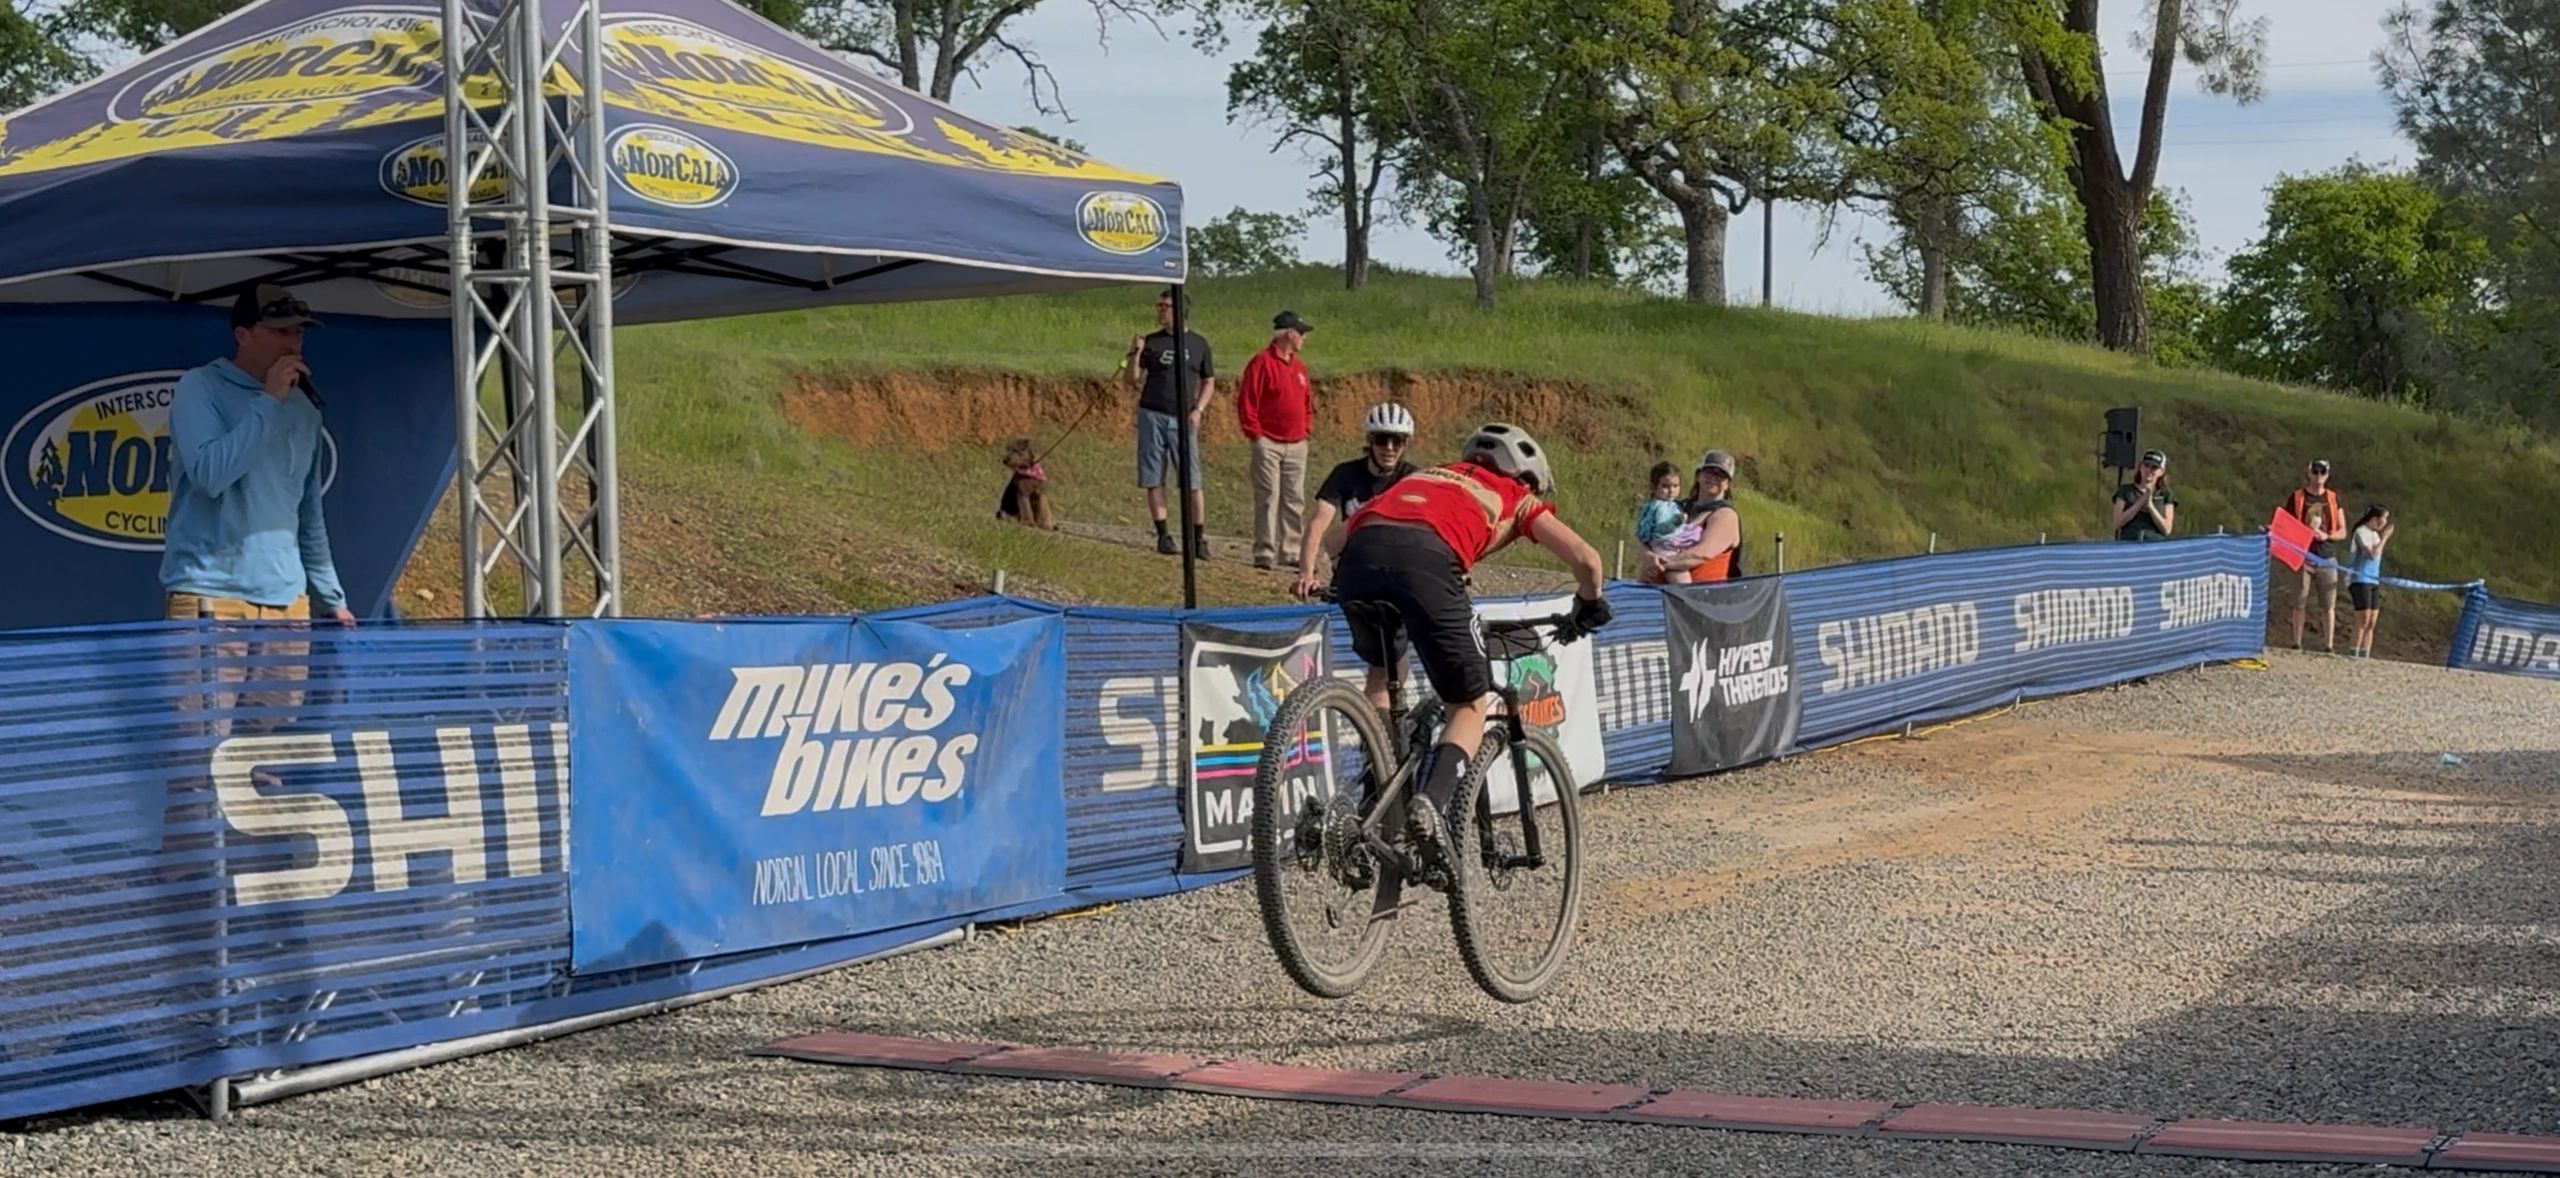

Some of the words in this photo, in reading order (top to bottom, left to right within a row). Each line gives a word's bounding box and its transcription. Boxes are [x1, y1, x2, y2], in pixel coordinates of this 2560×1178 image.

[2014, 586, 2134, 653] SHIMANO
[2160, 573, 2252, 630] SHIMANO
[1719, 640, 1773, 677] HYPER
[1818, 601, 1979, 694] SHIMANO
[1719, 665, 1789, 707] THREADS
[210, 722, 569, 906] SHI
[1205, 776, 1318, 828] MAIN
[753, 855, 814, 906] NORCAL
[816, 849, 864, 898] LOCAL
[869, 844, 910, 891] SINCE
